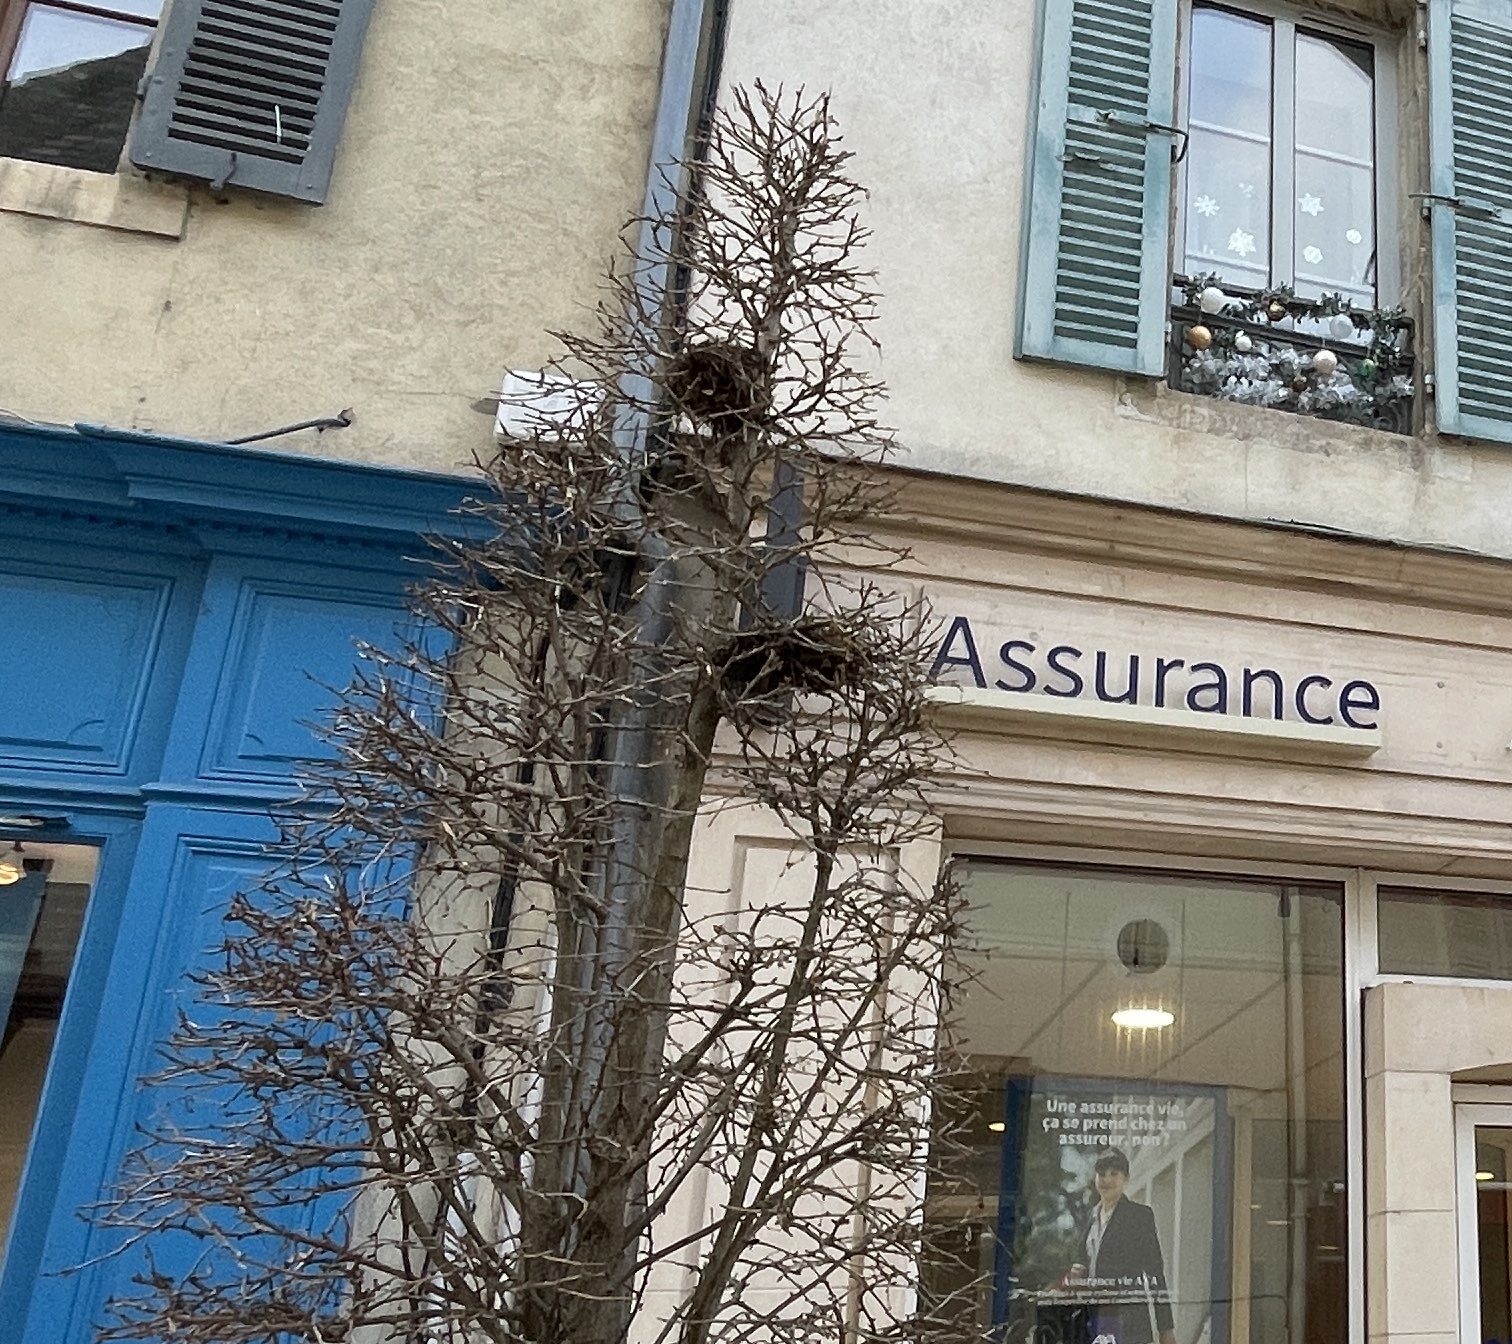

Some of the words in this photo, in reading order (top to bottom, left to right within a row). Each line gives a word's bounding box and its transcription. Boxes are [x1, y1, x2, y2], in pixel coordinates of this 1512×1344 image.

[928, 615, 1381, 730] Assurance
[1046, 1099, 1077, 1114] Une
[1080, 1102, 1154, 1115] assurance
[1042, 1117, 1060, 1132] ça
[1062, 1118, 1080, 1130] se
[1083, 1117, 1128, 1131] prend
